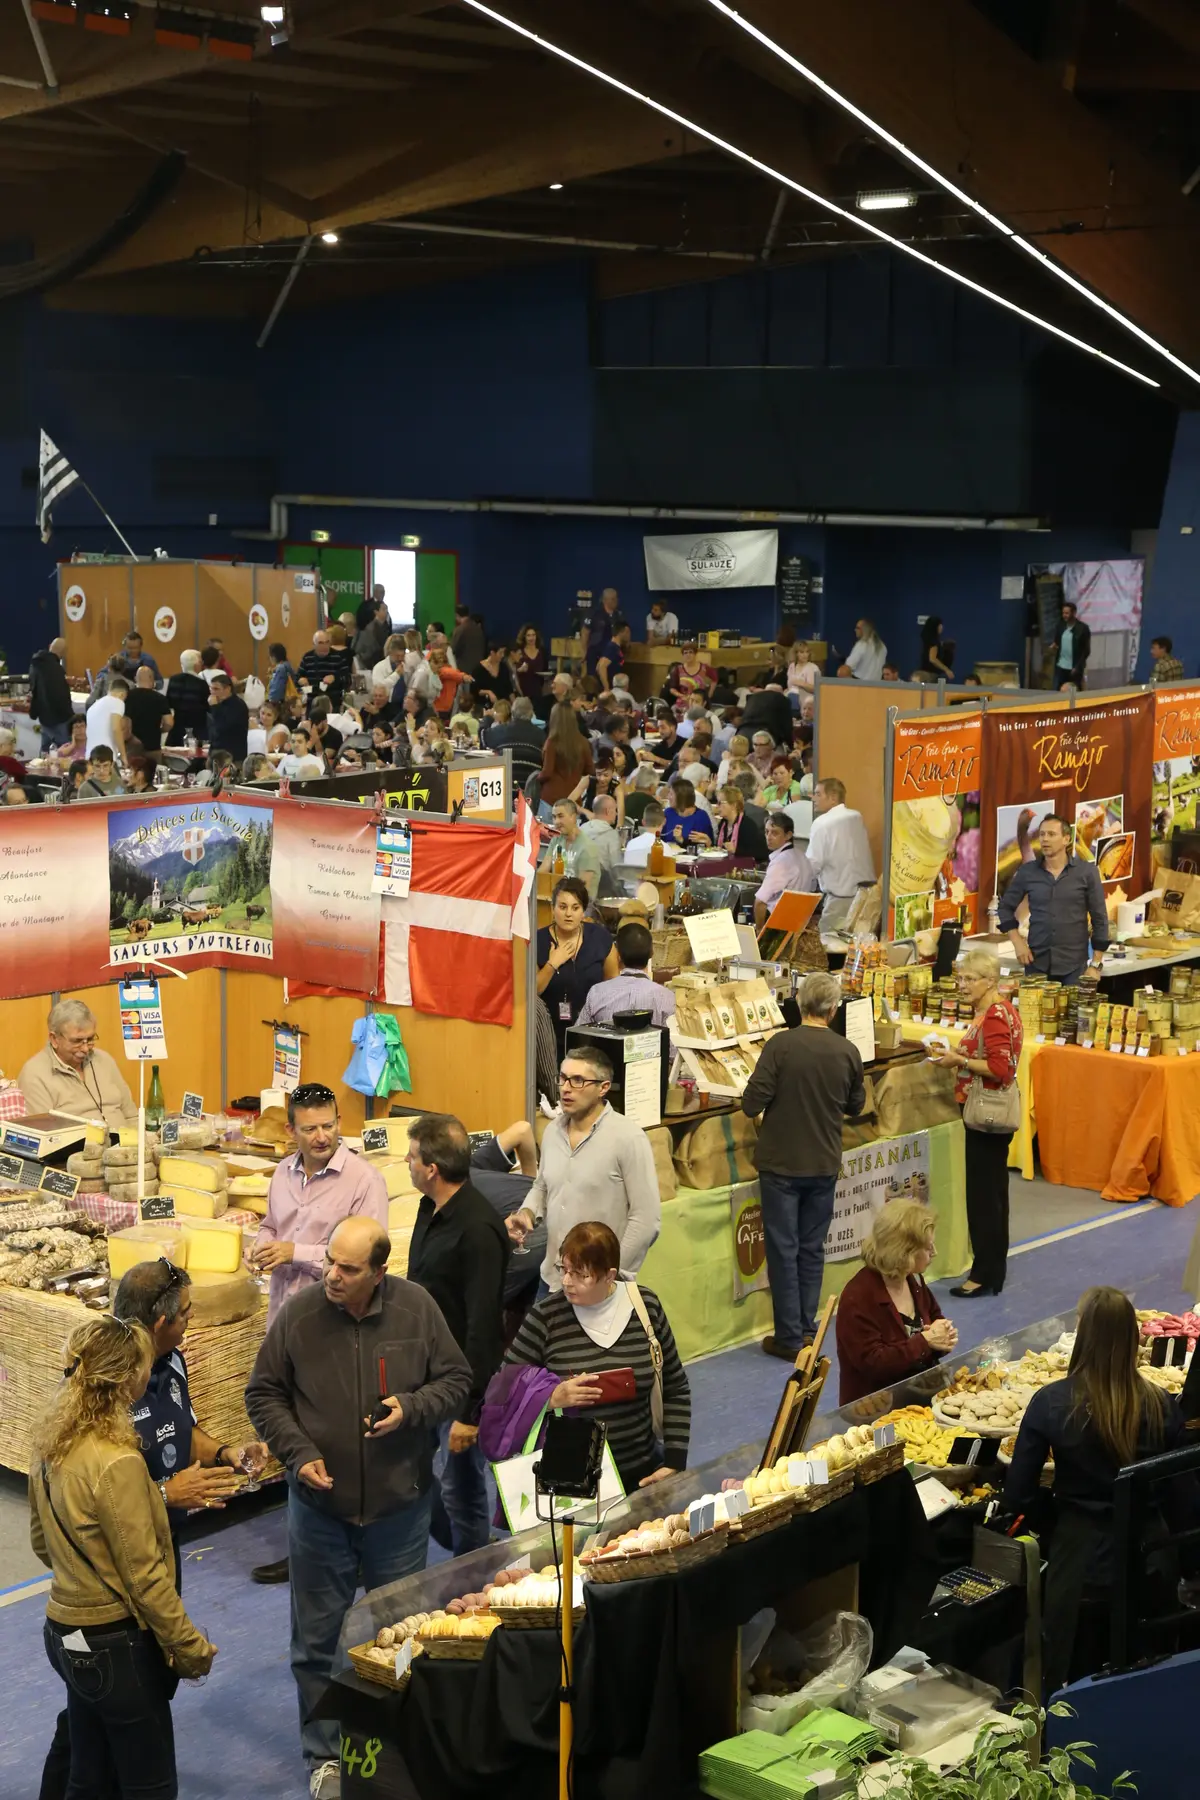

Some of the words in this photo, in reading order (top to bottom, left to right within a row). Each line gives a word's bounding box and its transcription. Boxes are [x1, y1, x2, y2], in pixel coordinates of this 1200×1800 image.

[691, 560, 732, 570] SULAUZE
[303, 578, 314, 587] E24
[324, 580, 364, 594] SORTIE
[1000, 724, 1012, 732] Foie
[1014, 722, 1028, 730] Gras
[1034, 719, 1056, 728] Confits
[1064, 716, 1080, 724] Plats
[1082, 712, 1106, 722] cuisinés
[1113, 707, 1140, 717] Terrines
[1060, 732, 1072, 746] Foie
[1074, 731, 1089, 750] Gras
[926, 742, 938, 757] Foie
[942, 741, 958, 761] Gras
[1033, 736, 1108, 792] Ramajo
[898, 744, 980, 806] Ramajo
[480, 780, 502, 798] G13
[138, 814, 186, 844] Délices
[190, 808, 206, 822] de
[211, 807, 252, 842] Savoie
[2, 846, 44, 856] Beaufort
[311, 838, 334, 850] Tomme
[336, 844, 344, 852] de
[346, 844, 371, 854] Savoie
[396, 856, 410, 864] VISA
[0, 870, 48, 880] Abondance
[318, 862, 356, 876] Reblochon
[394, 868, 410, 876] VISA
[308, 884, 330, 896] Tomme
[333, 889, 340, 897] de
[4, 894, 42, 904] Raclette
[22, 915, 64, 925] Montagne
[320, 909, 352, 922] Gruyère
[114, 940, 178, 961] SAVEURS
[188, 935, 272, 956] D'AUTREFOIS
[864, 1182, 870, 1191] ET
[838, 1228, 854, 1241] UZÈS
